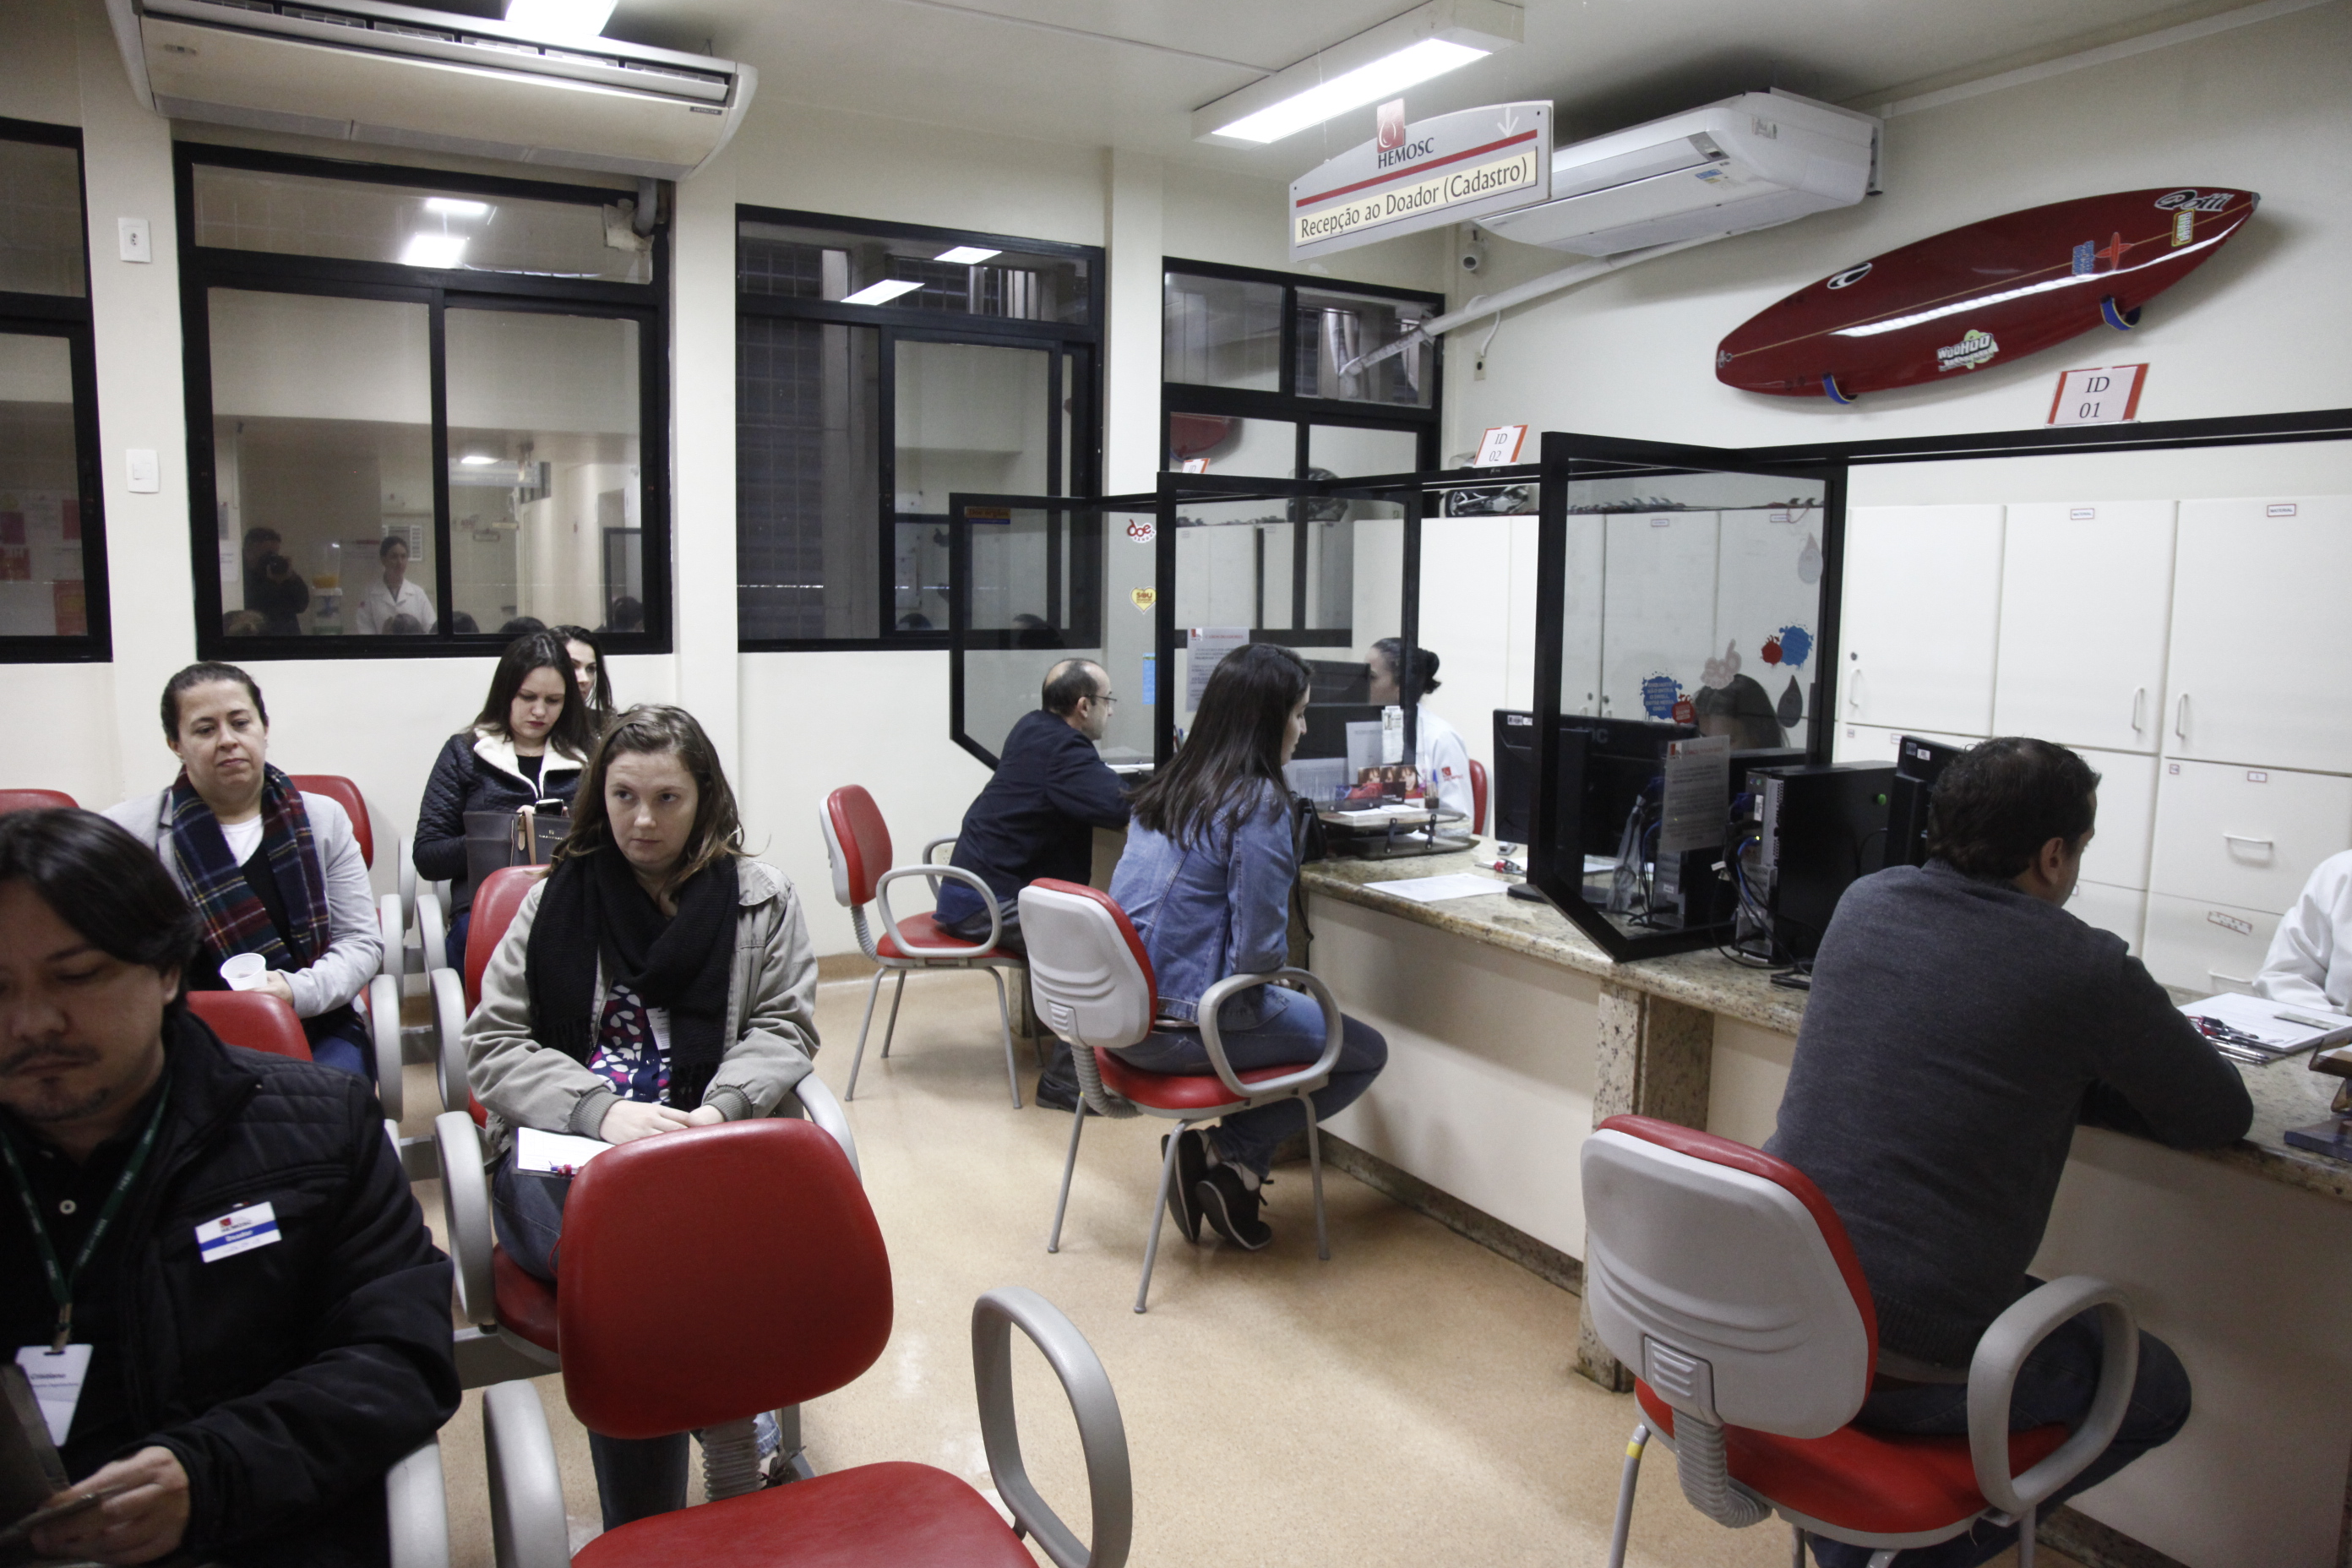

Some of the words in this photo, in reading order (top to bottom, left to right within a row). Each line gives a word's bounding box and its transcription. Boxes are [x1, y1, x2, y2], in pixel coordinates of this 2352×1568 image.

[1378, 137, 1435, 169] HEMOSC
[1301, 208, 1360, 238] Recepção
[1364, 203, 1380, 220] ao
[1386, 185, 1440, 215] Doador
[1443, 156, 1527, 204] (Cadastro)
[2085, 377, 2110, 394] ID
[2079, 402, 2100, 418] 01
[1494, 433, 1508, 444] ID
[1489, 450, 1501, 461] 02
[1127, 519, 1152, 537] doe
